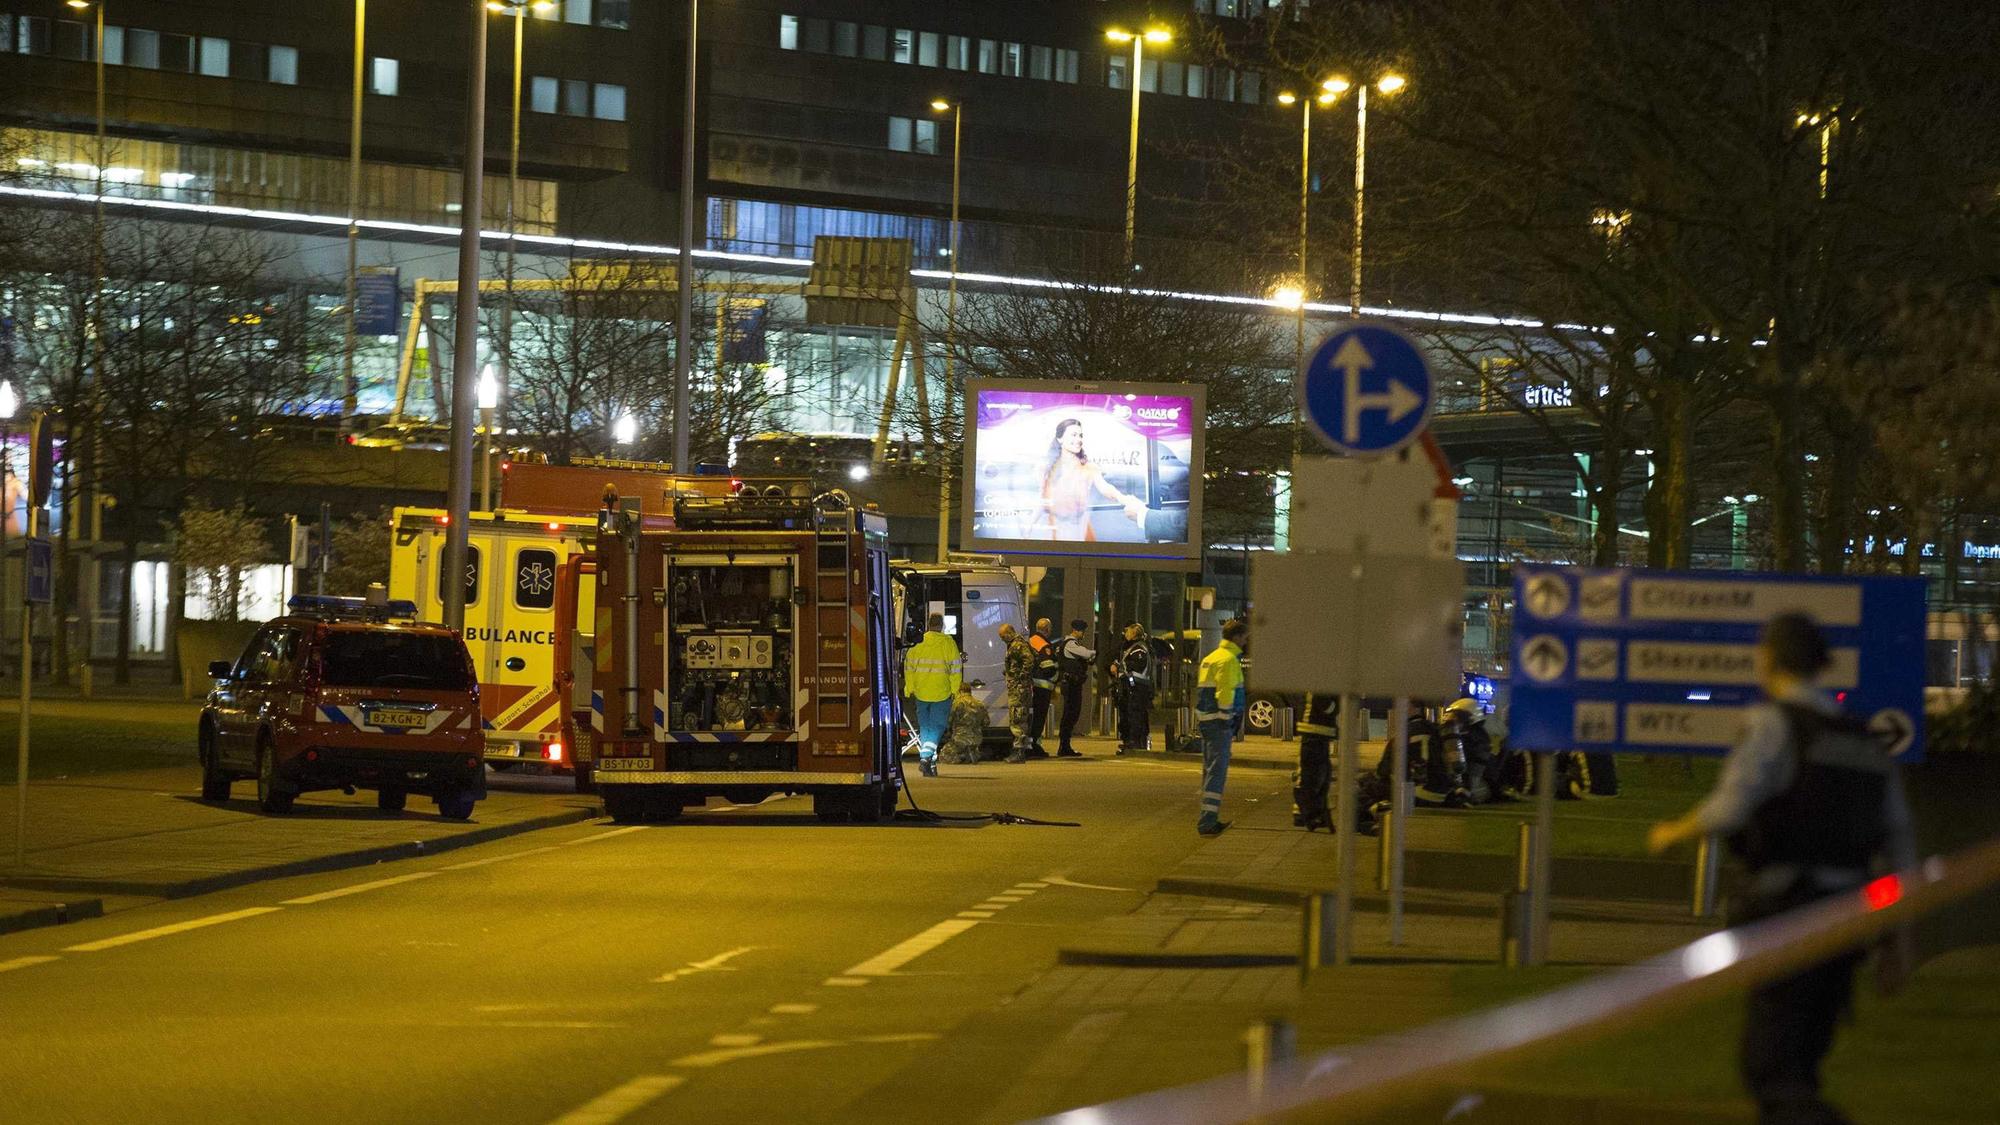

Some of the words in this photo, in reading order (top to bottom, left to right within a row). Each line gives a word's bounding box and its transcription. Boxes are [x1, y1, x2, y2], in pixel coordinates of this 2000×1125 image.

[1137, 407, 1168, 420] QATAR
[1640, 648, 1754, 675] Sheraton
[803, 676, 865, 685] BRNDWER
[496, 708, 521, 727] Airport
[522, 685, 551, 711] Schiphol
[374, 713, 423, 725] 82-KGN-2
[1638, 713, 1694, 734] WTC
[604, 759, 650, 769] BS-TV-03
